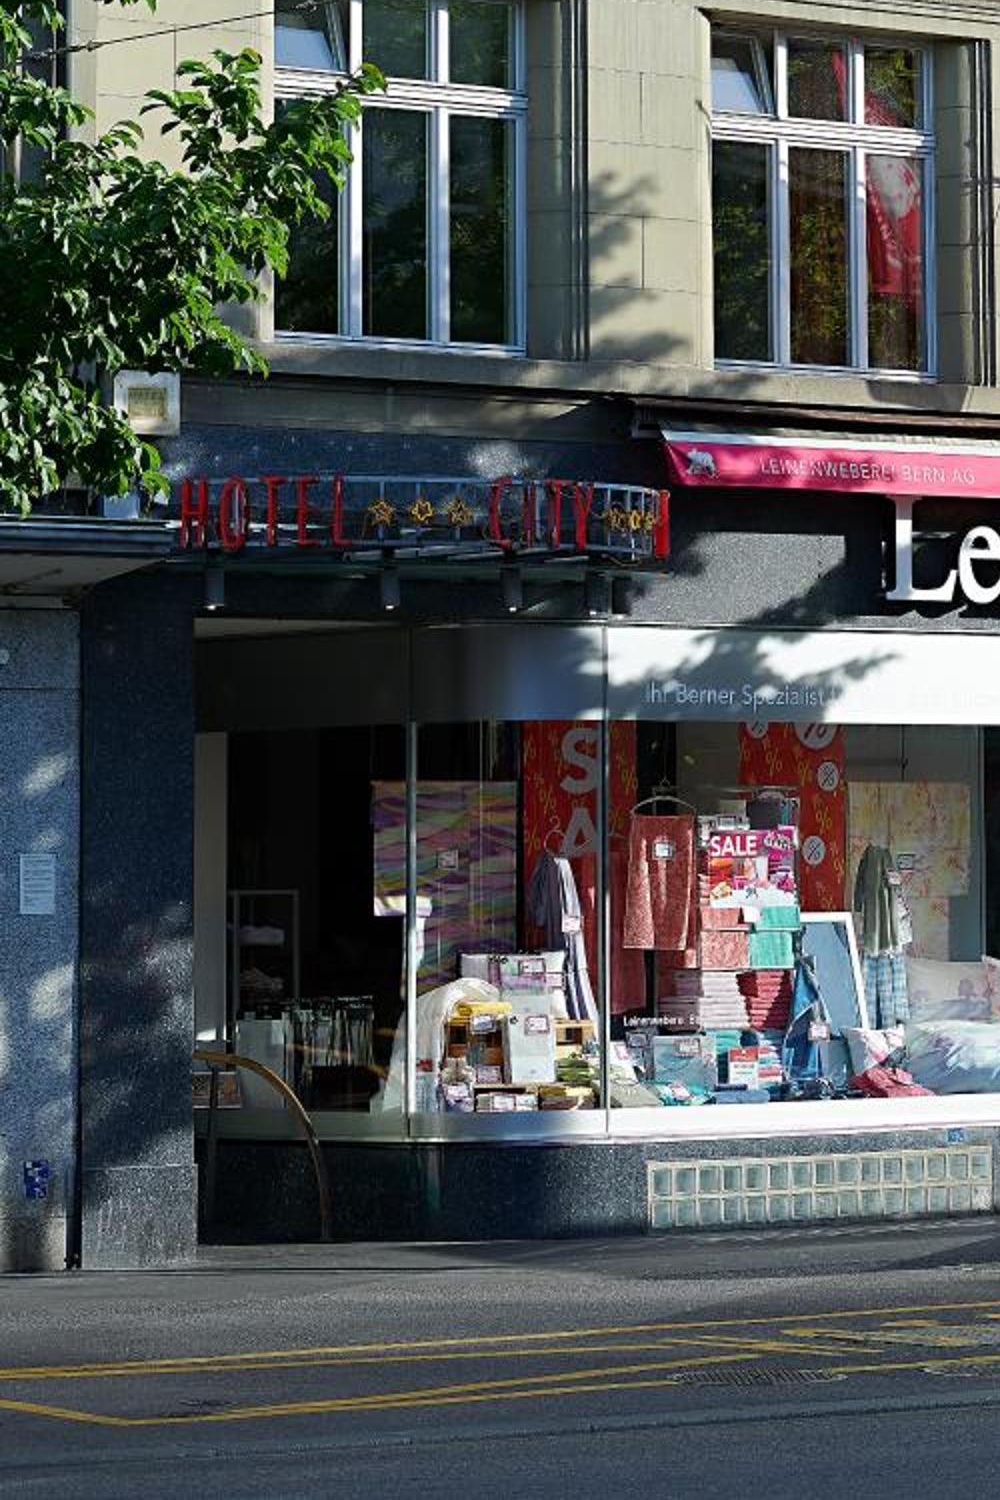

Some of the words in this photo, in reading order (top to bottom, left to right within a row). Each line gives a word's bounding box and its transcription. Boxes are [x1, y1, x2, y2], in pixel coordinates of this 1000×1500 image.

[952, 467, 976, 485] AG
[179, 474, 353, 551] HOTEL
[489, 476, 594, 551] CITY
[675, 683, 736, 706] Berner
[710, 835, 759, 857] SALE
